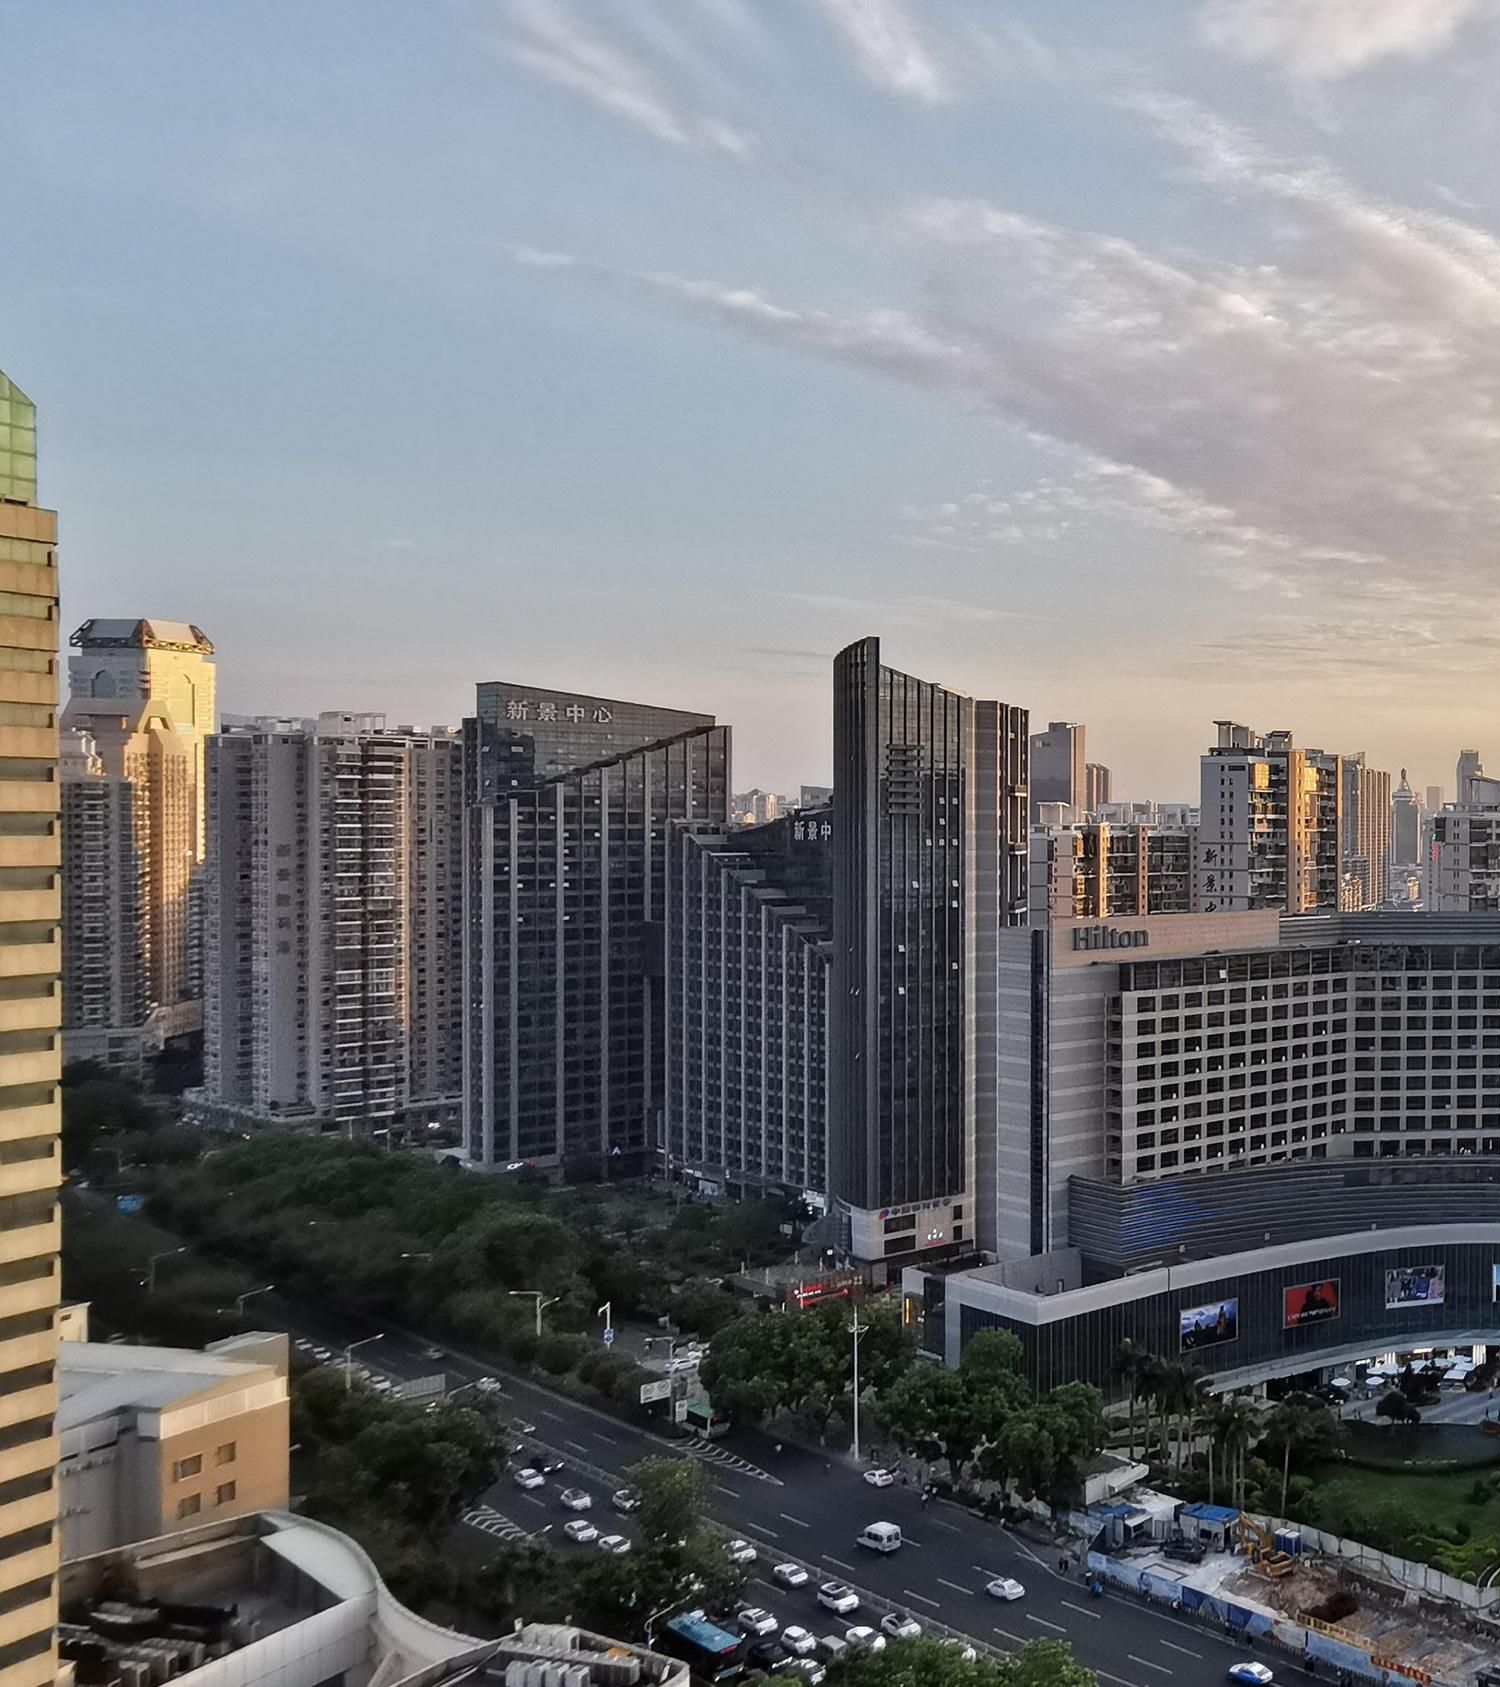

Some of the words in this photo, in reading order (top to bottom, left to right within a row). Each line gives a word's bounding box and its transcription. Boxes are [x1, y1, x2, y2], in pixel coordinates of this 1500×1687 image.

[506, 699, 613, 723] 新景中心
[793, 820, 832, 841] 新景中
[1072, 924, 1150, 951] Hilton
